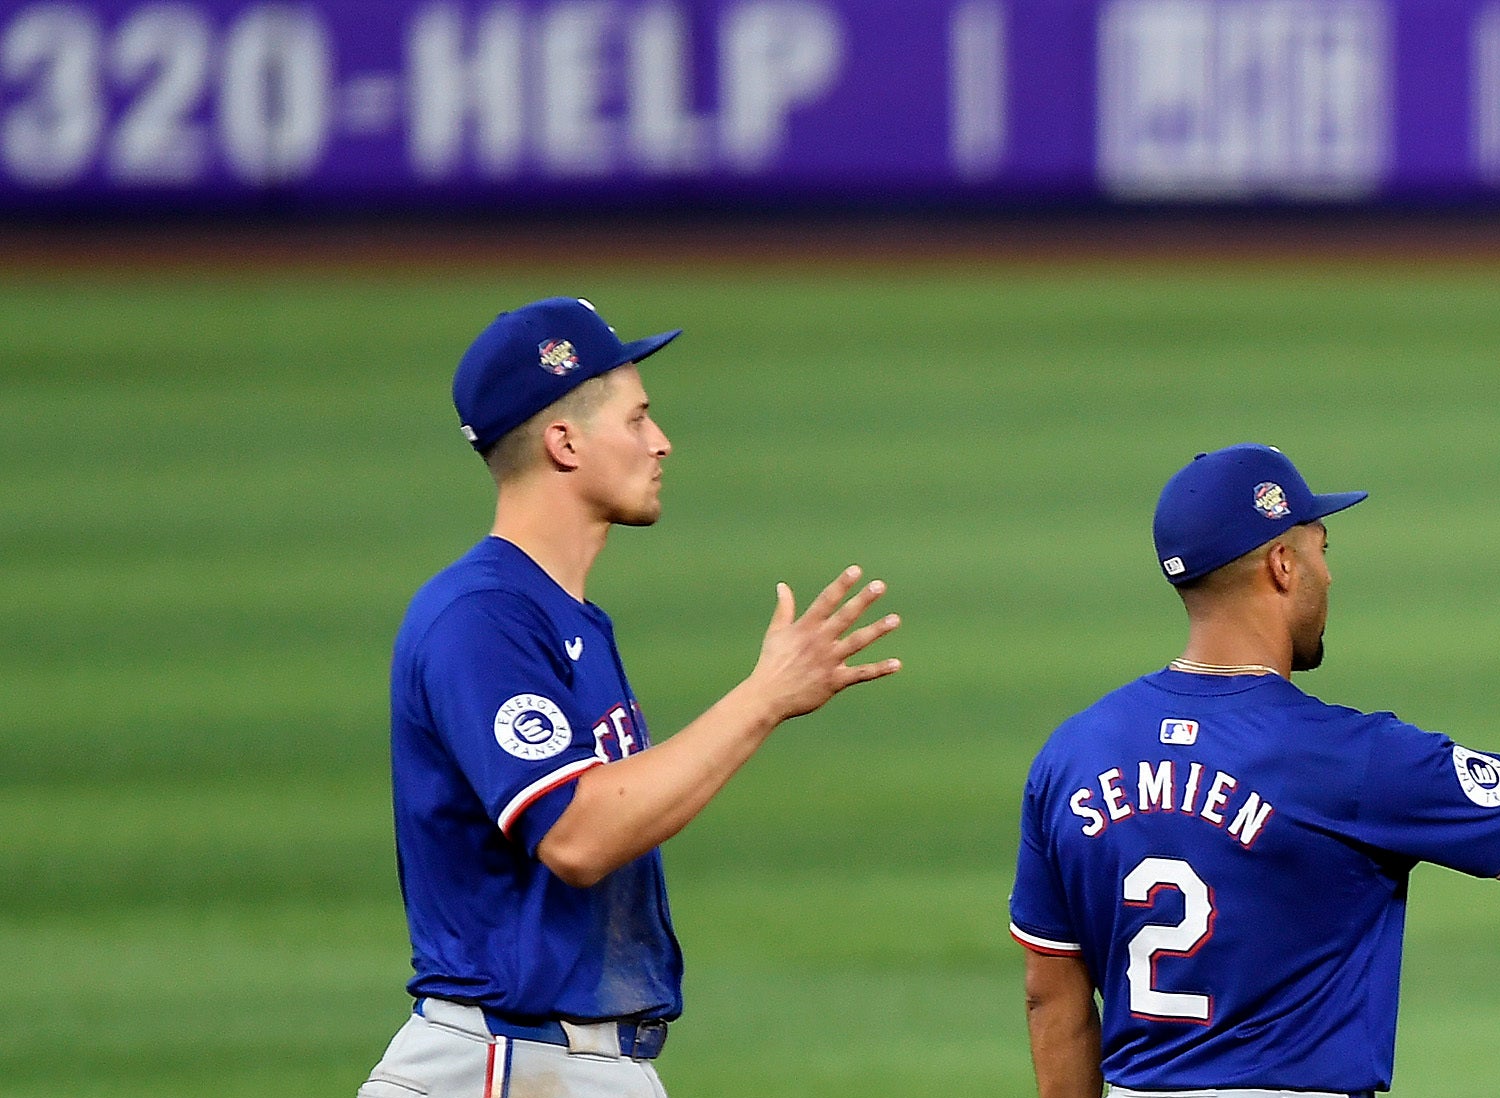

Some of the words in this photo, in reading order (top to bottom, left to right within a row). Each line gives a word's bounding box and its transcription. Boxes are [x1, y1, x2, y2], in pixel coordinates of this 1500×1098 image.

[0, 2, 842, 187] 320-HELP
[498, 696, 558, 725] ENERGY
[1069, 760, 1274, 849] SEMIEN
[1123, 856, 1219, 1026] 2
